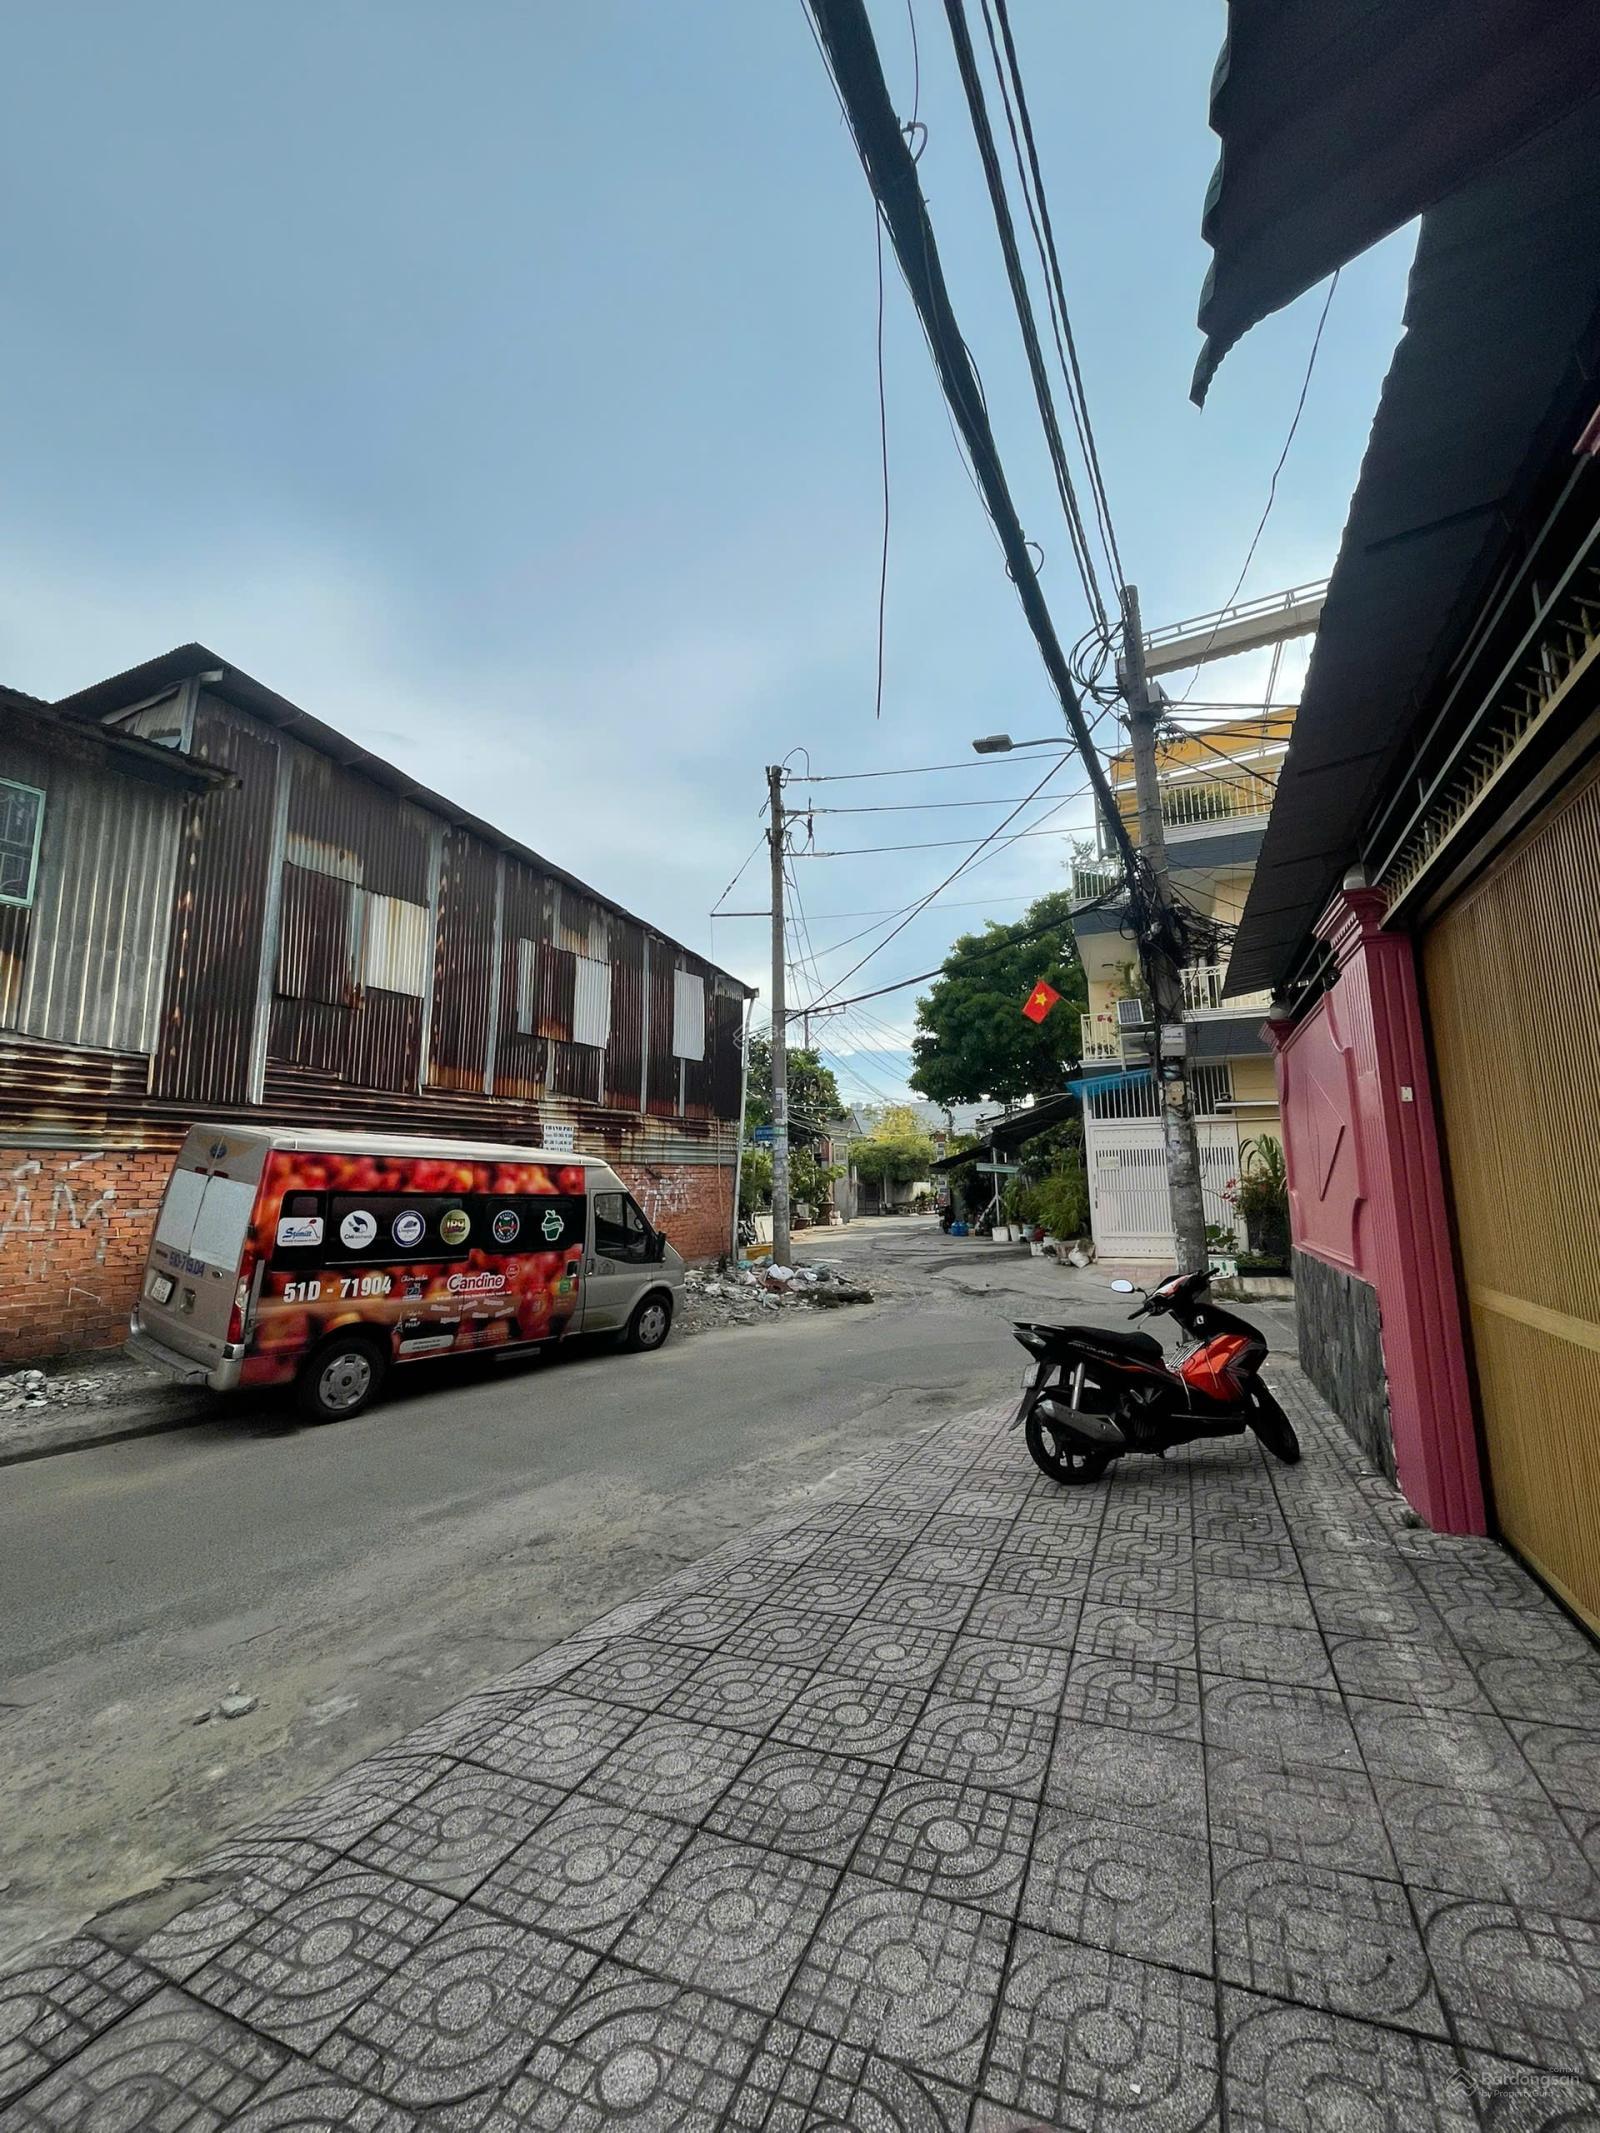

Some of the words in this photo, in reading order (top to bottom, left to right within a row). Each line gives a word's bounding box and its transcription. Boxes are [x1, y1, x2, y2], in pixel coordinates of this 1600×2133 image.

[283, 1280, 321, 1303] 51D
[340, 1275, 392, 1298] 71904
[447, 1272, 505, 1292] Candine
